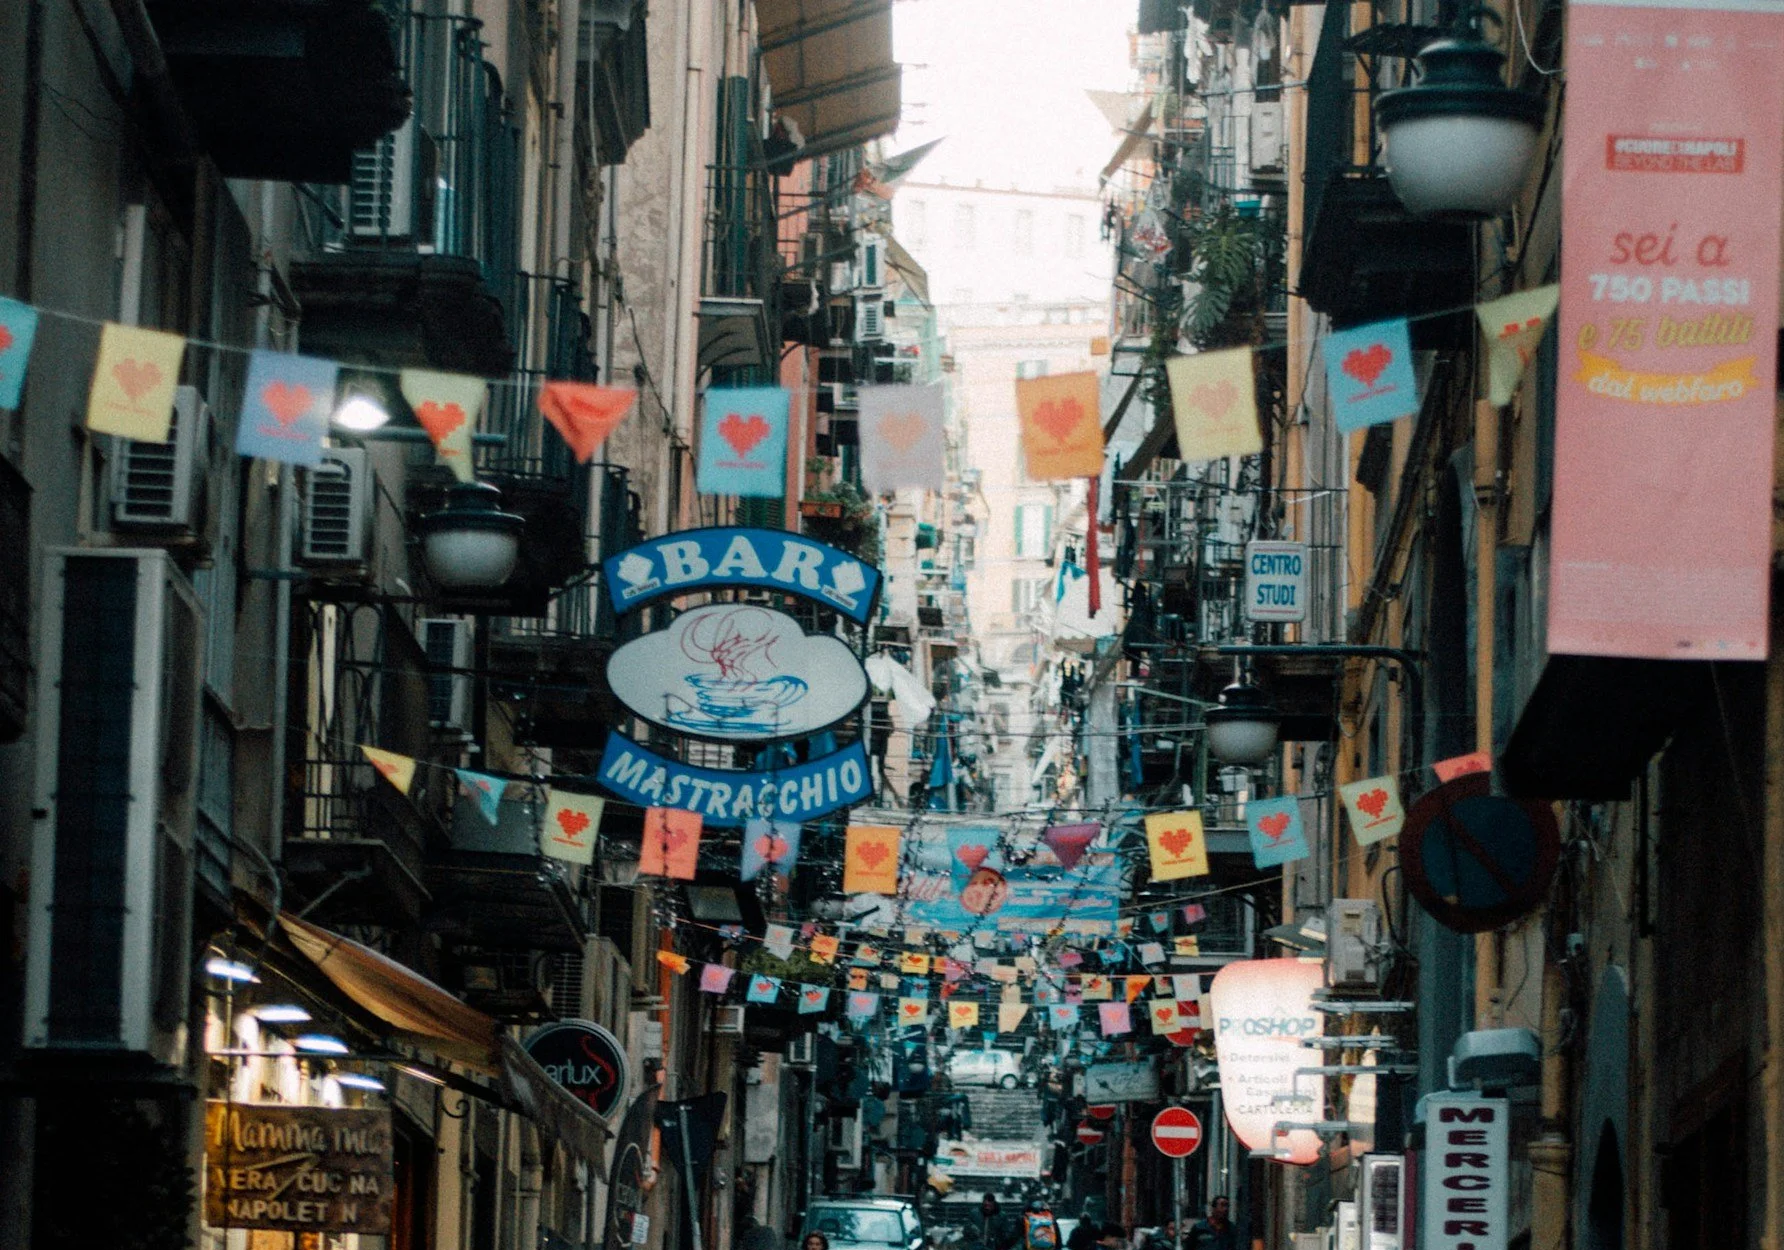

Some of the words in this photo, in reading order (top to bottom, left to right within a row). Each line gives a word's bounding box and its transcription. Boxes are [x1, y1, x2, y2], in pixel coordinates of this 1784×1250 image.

[1609, 222, 1680, 266] sei
[1697, 234, 1730, 268] a
[1589, 273, 1652, 302] 750
[1661, 277, 1750, 306] PASSI
[1578, 322, 1598, 351] e
[1608, 317, 1647, 350] 75
[1588, 371, 1634, 400] dal
[656, 534, 825, 590] BAR
[1251, 554, 1302, 576] CENTRO
[1256, 584, 1296, 606] STUDI
[606, 750, 863, 818] MASTRACCHIO
[543, 1058, 602, 1085] arlux
[214, 1106, 328, 1152] Mamma
[334, 1126, 386, 1155] mia
[296, 1171, 380, 1196] CUCNA
